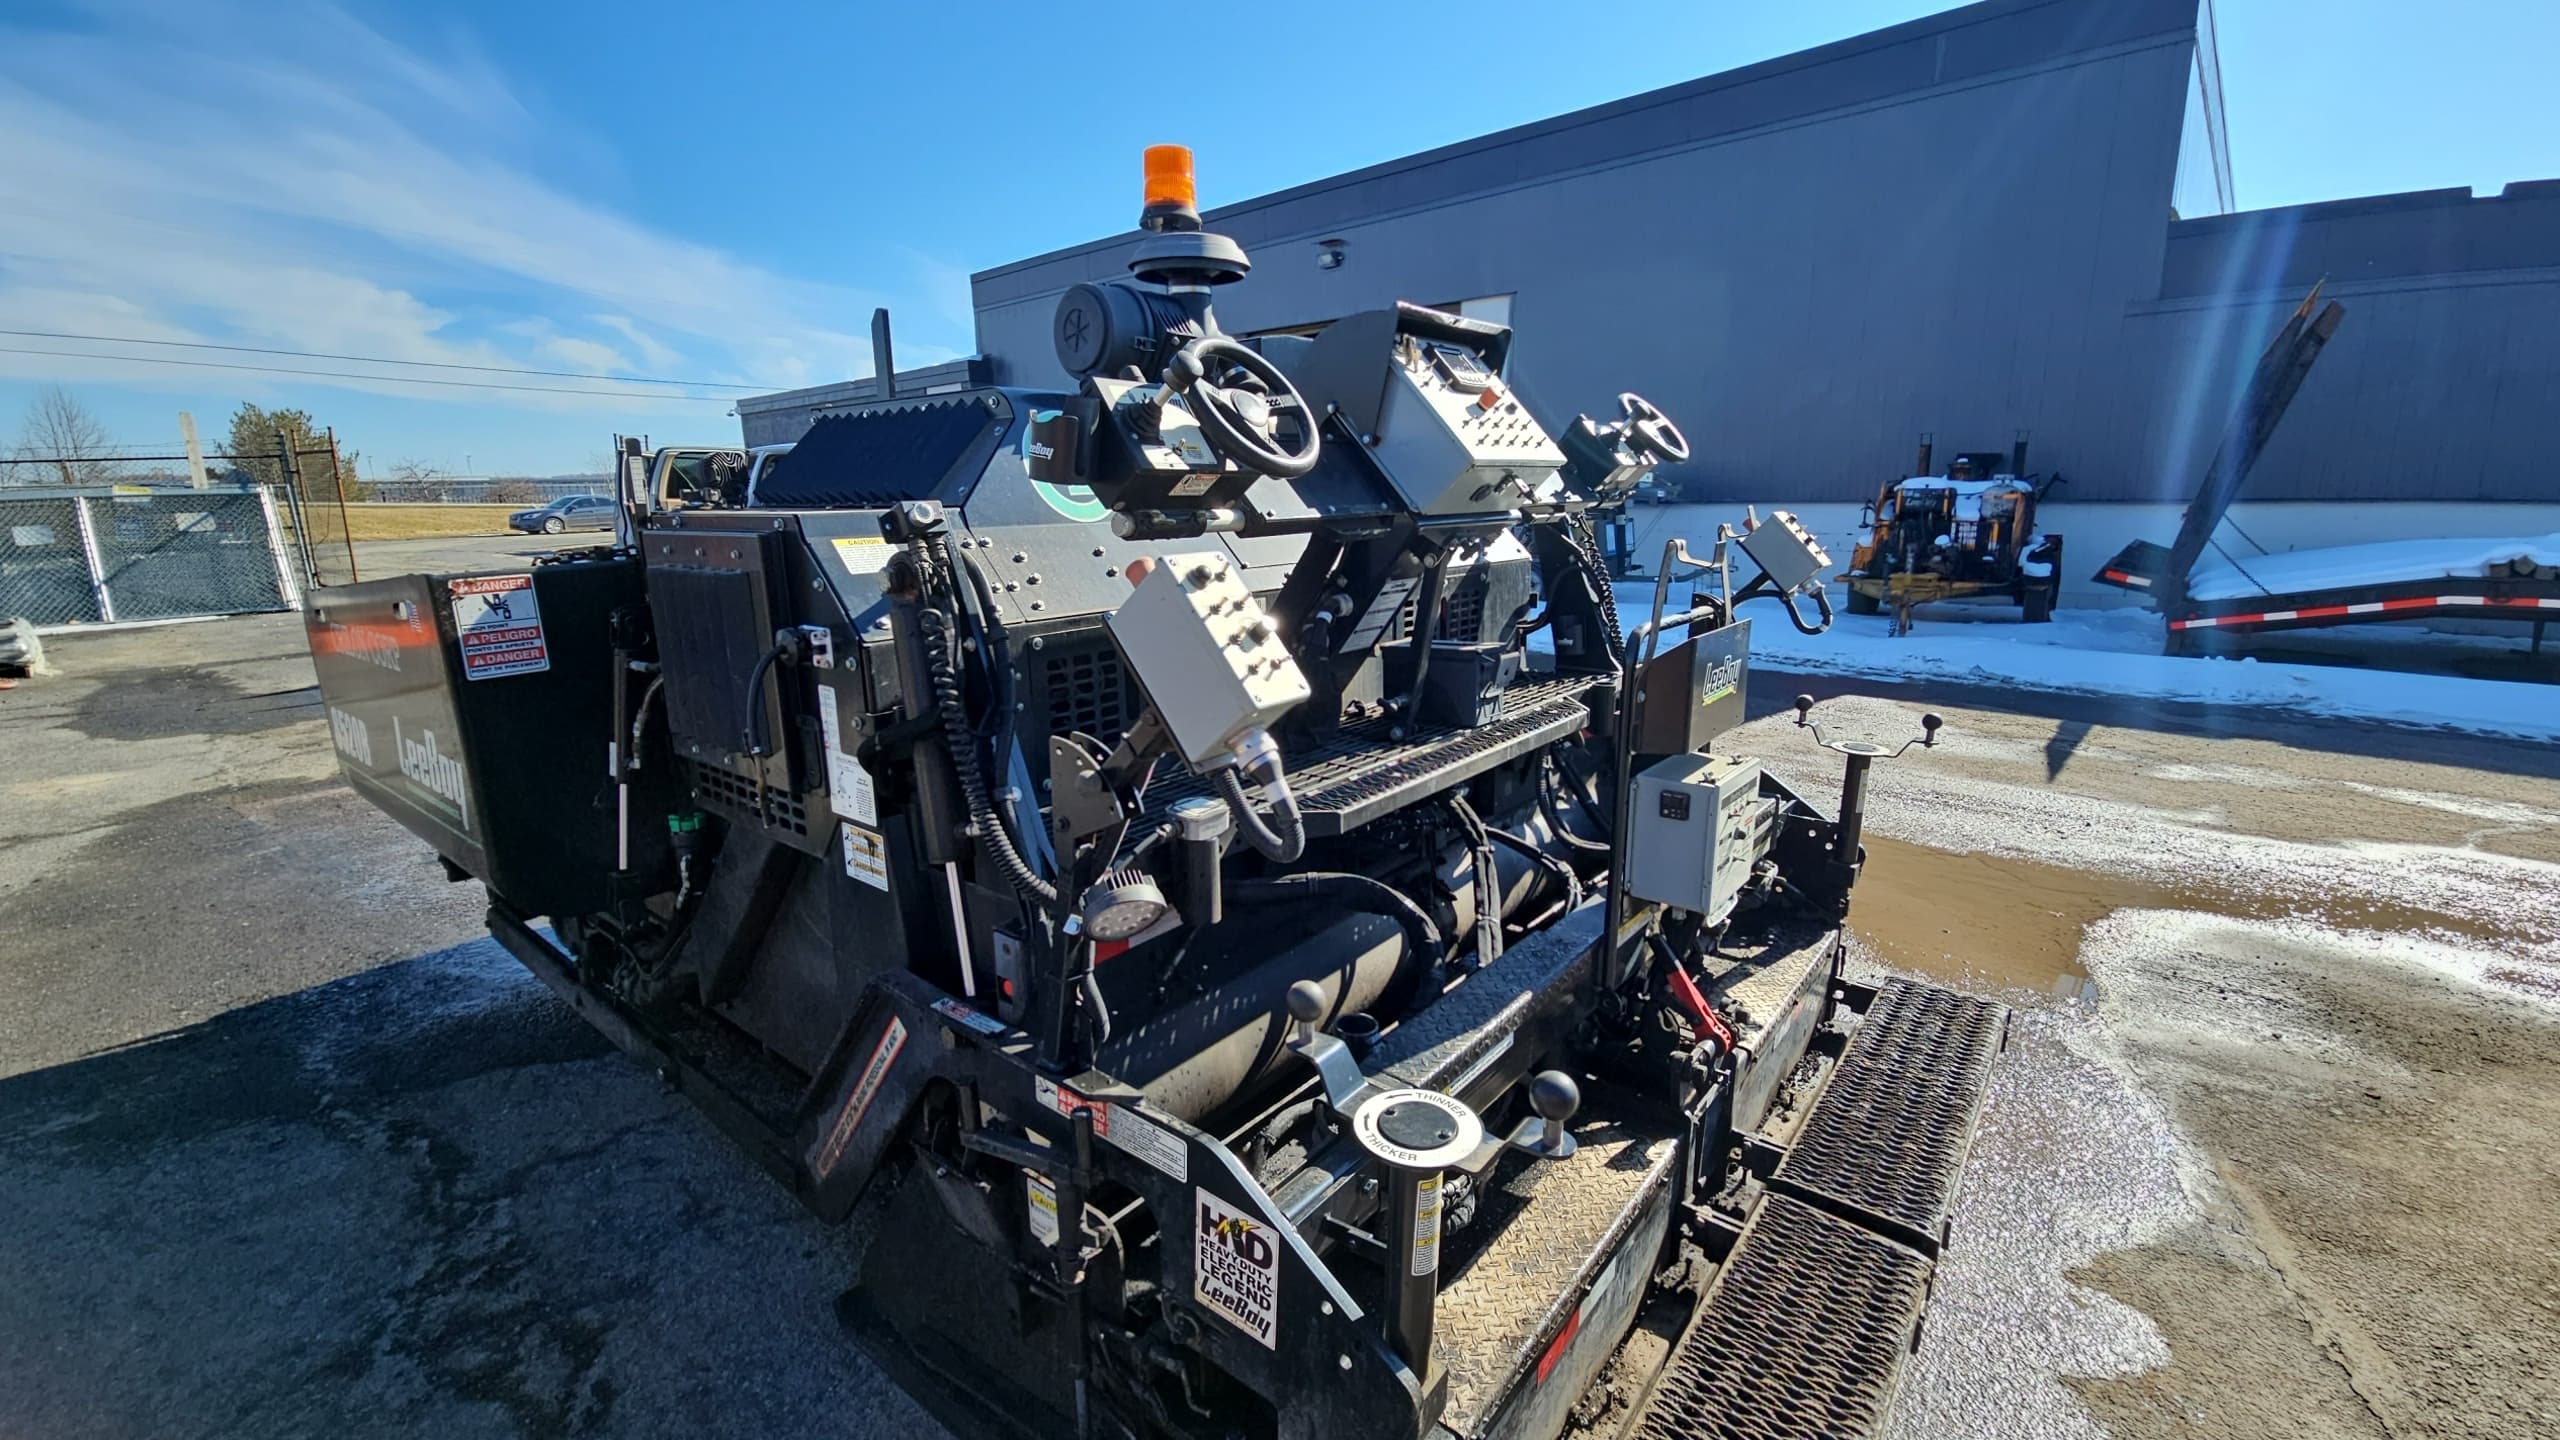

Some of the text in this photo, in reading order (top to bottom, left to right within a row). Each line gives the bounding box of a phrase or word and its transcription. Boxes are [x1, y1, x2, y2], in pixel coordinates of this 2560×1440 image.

[1029, 442, 1054, 460] eBoy
[473, 578, 526, 592] DANGER
[481, 629, 537, 643] PELIGRO
[486, 649, 540, 664] DANGER
[1703, 655, 1742, 698] LeeBoy
[392, 715, 470, 831] LeeBoy
[1415, 1092, 1466, 1118] THINNER
[1366, 1133, 1418, 1162] THICKER
[1201, 1235, 1272, 1284] HEAVY DUTY
[1201, 1245, 1274, 1298] ELECTRIC
[1201, 1258, 1272, 1312] LEGEND
[1201, 1275, 1272, 1339] LeeBoy
